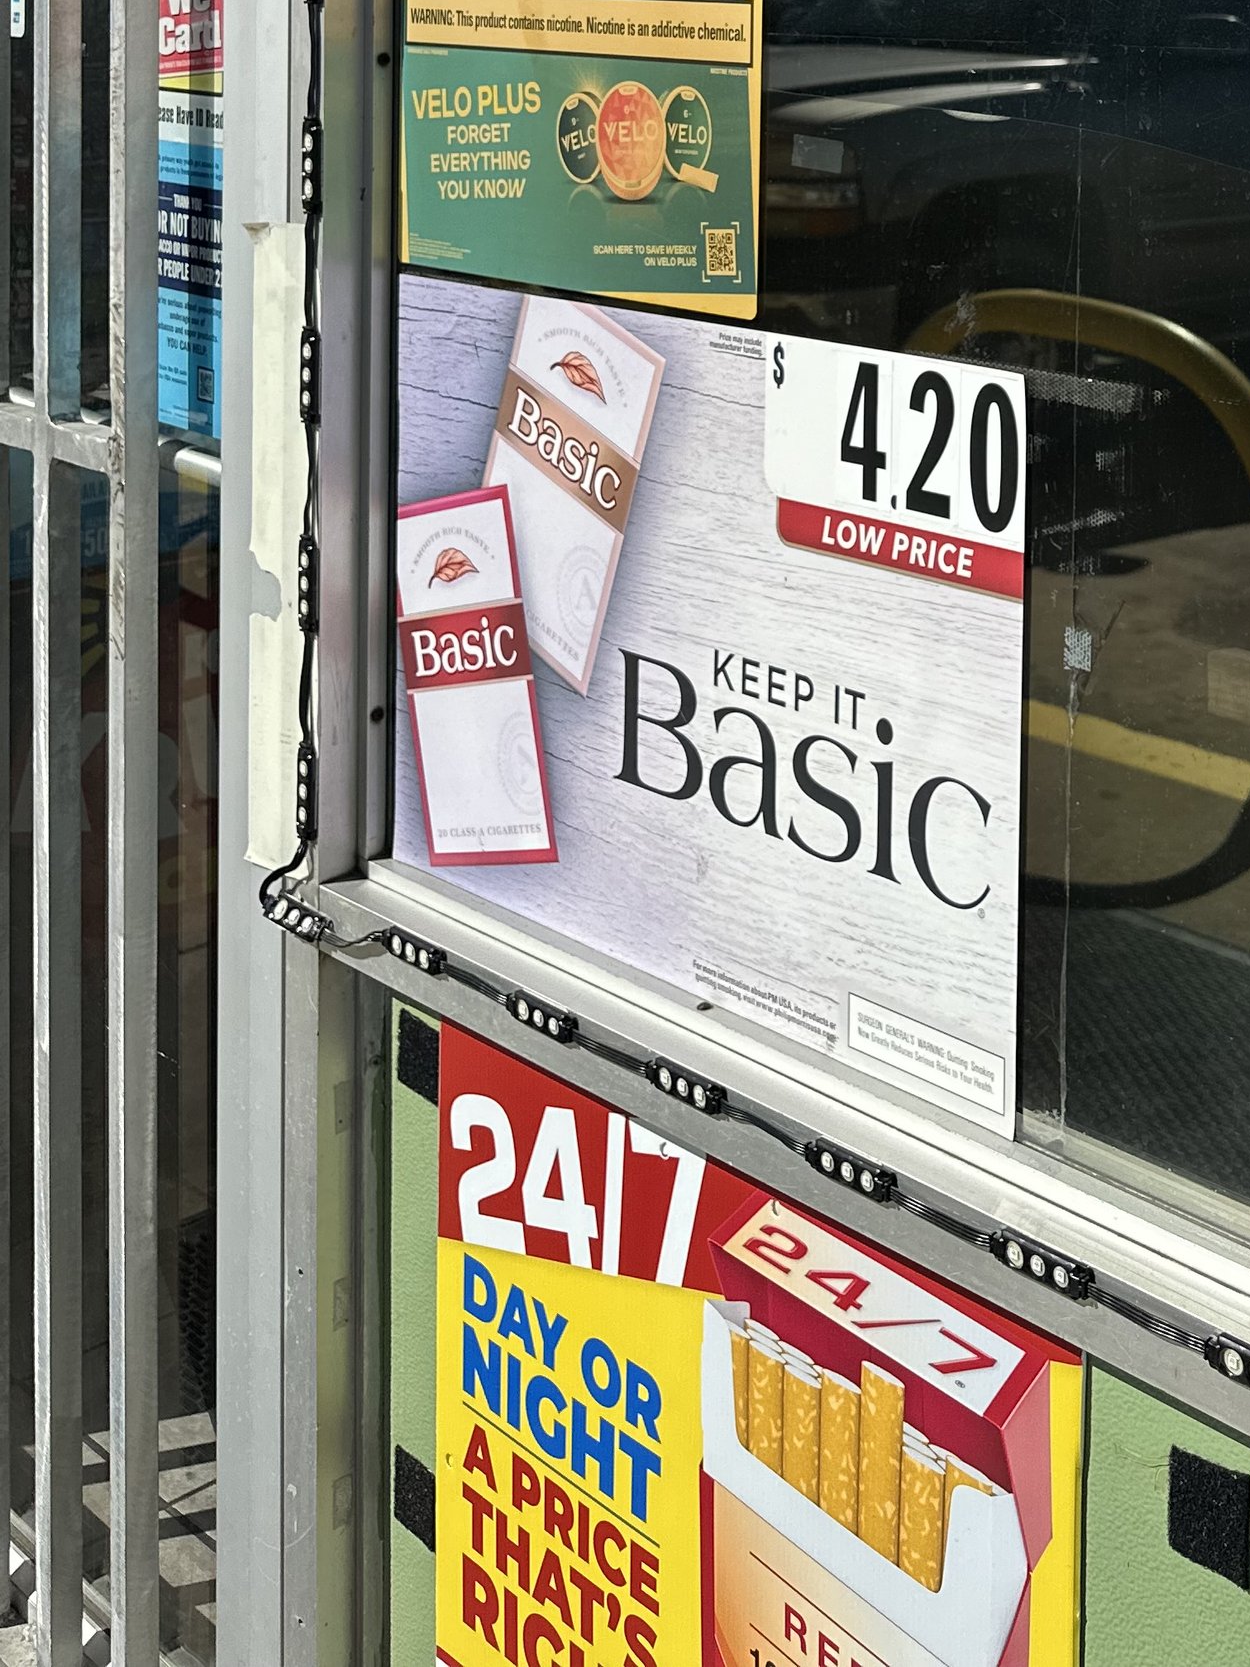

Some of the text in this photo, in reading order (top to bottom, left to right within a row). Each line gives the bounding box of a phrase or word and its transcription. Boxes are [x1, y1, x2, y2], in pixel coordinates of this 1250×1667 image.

[159, 9, 222, 56] Card
[410, 8, 747, 42] WARNING: This product contains nicotine. Nicotine is an addictive chemical.
[176, 105, 194, 126] Have
[411, 81, 542, 120] VELO PLUS
[447, 122, 512, 145] FORGET
[561, 124, 597, 153] VELO
[602, 119, 659, 144] VELO
[668, 122, 708, 146] VELO
[430, 149, 532, 173] EVERYTHING
[437, 177, 527, 200] YOU KNOW
[170, 212, 190, 239] NOT
[593, 244, 697, 255] SCAN HERE TO SAVE WEEKLY
[643, 256, 698, 267] ON VELO PLUS
[163, 258, 190, 282] PEOPLE
[507, 386, 622, 511] Basic
[821, 515, 975, 579] LOW PRICE
[411, 615, 518, 677] Basic
[713, 648, 867, 731] KEEP IT
[613, 647, 992, 910] Basic
[437, 828, 449, 838] 20
[450, 826, 477, 838] CLASS
[487, 823, 542, 836] CIGARETTES
[742, 1223, 998, 1375] 24/7
[463, 1252, 662, 1445] DAY OR
[462, 1321, 662, 1524] NIGHT
[462, 1423, 661, 1618] A PRICE
[462, 1481, 659, 1667] THAT'S
